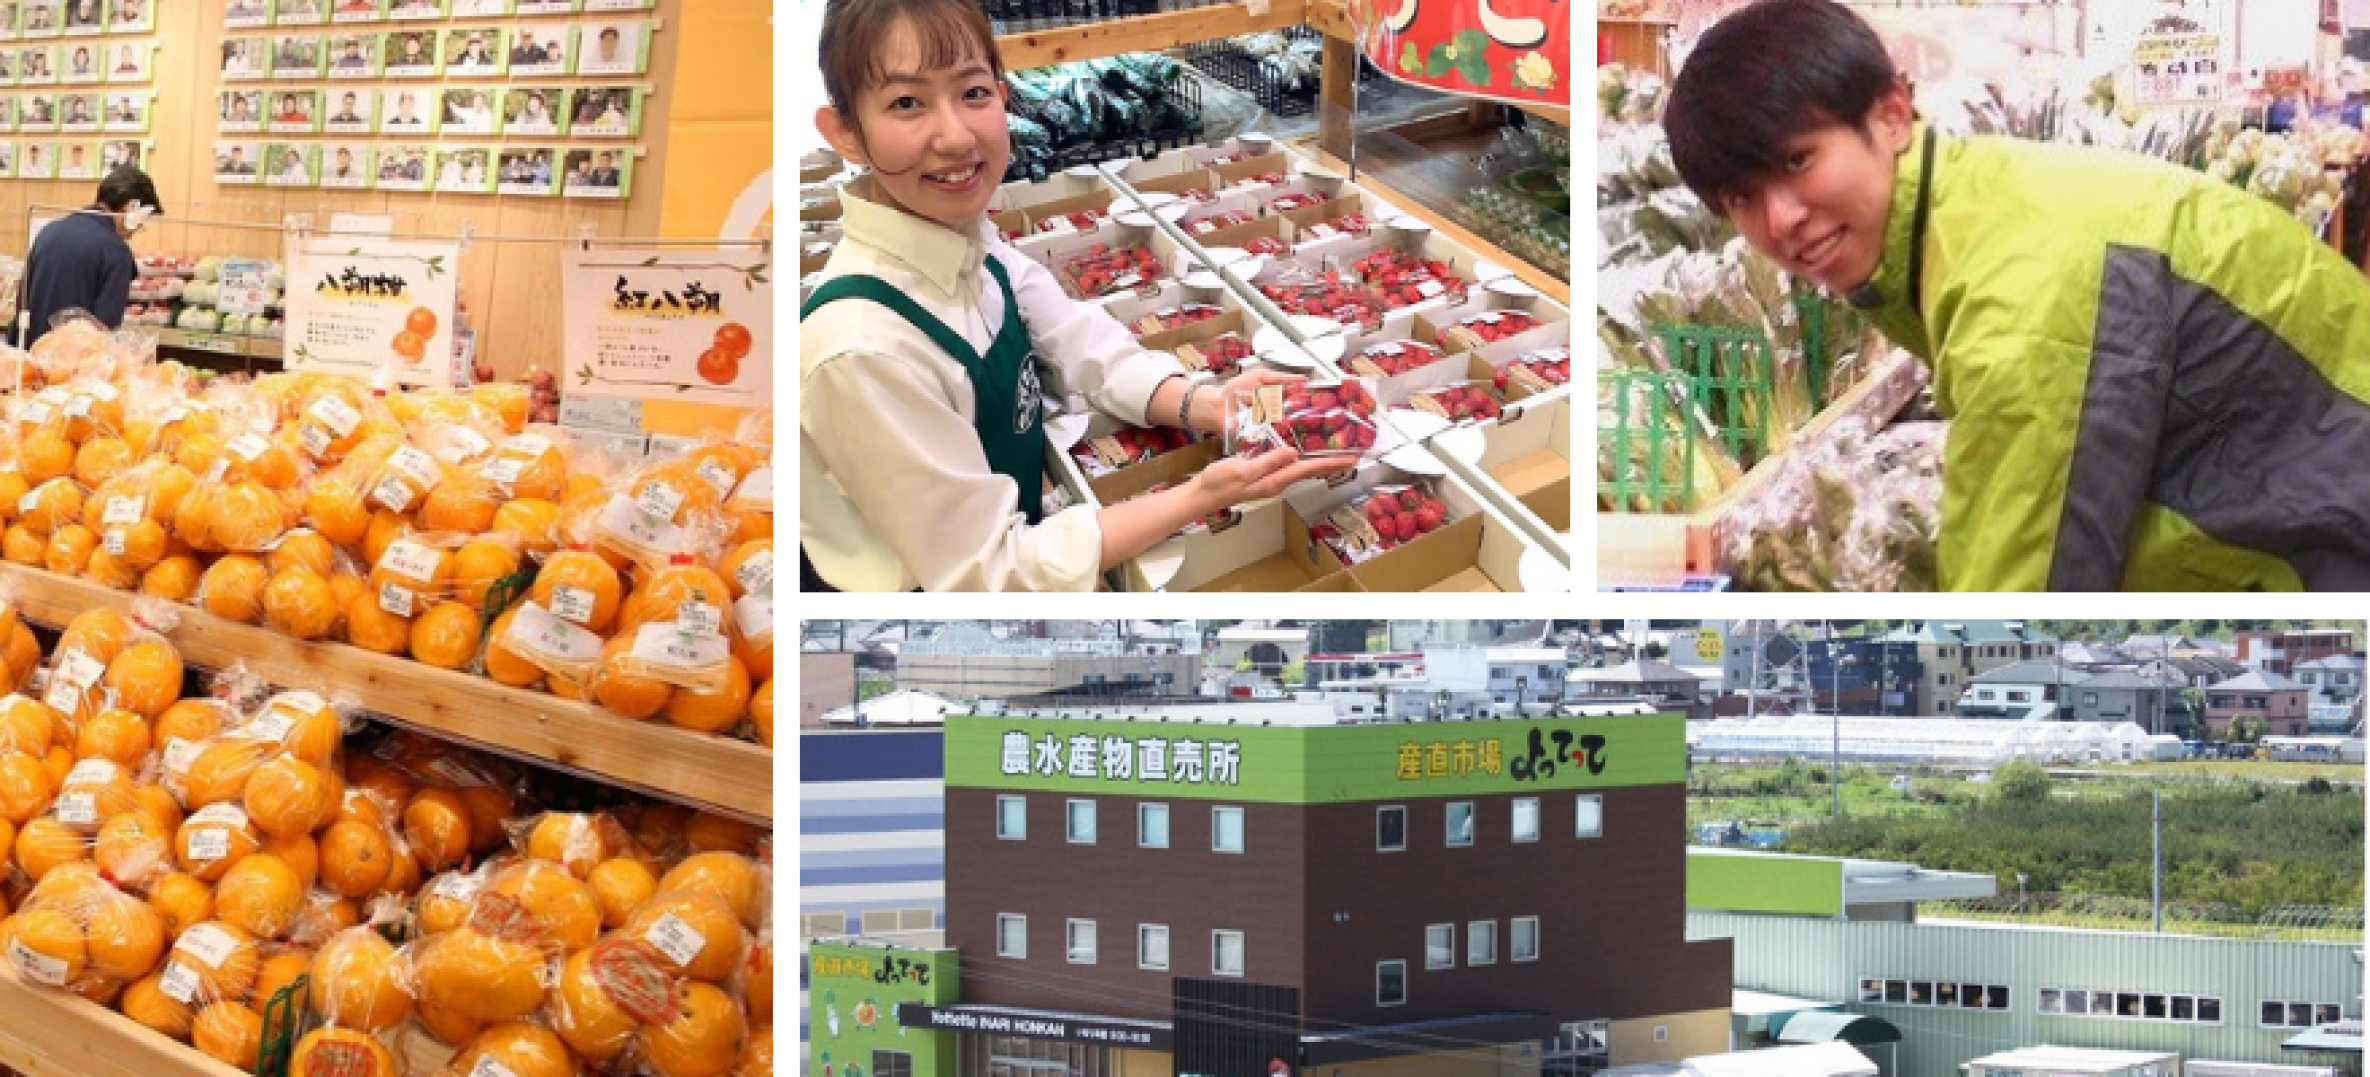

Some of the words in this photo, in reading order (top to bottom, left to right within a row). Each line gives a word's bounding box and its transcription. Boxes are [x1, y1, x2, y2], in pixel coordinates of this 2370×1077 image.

[1001, 730, 1241, 785] 農水産物直売所
[1398, 738, 1502, 781] 産直市場
[1511, 727, 1606, 781] よってって
